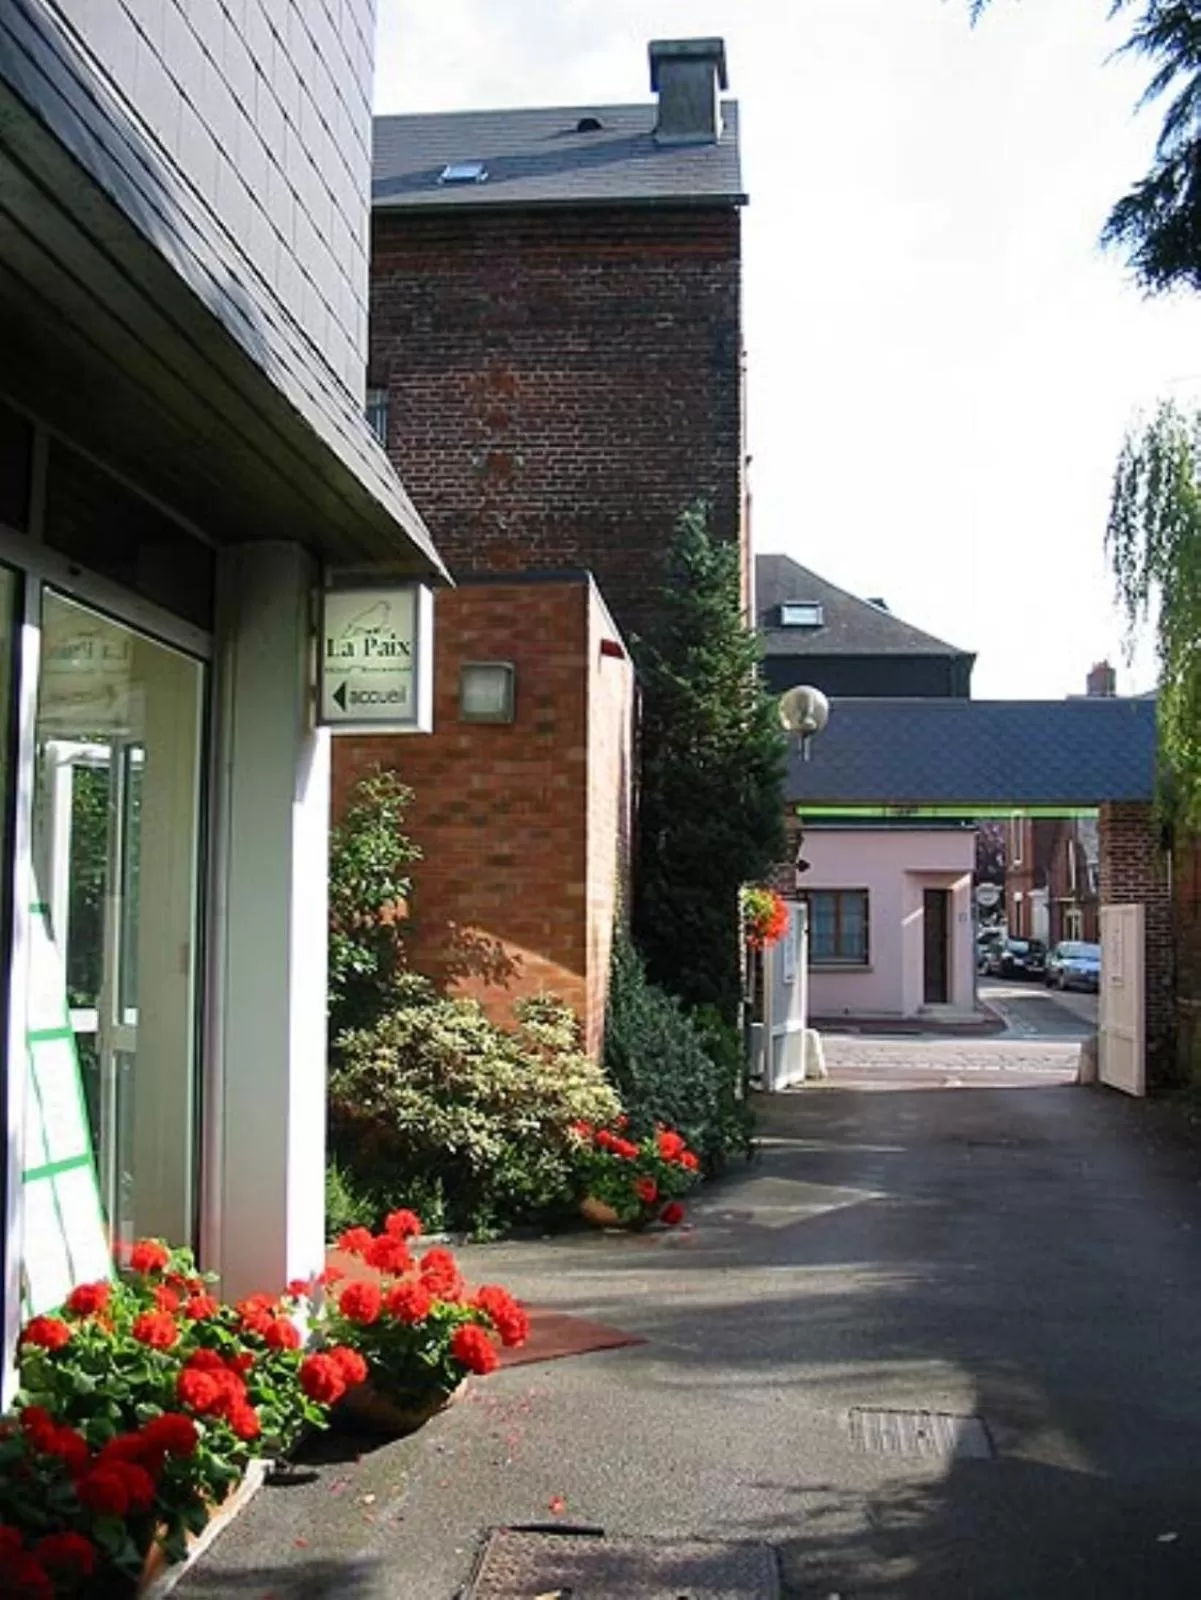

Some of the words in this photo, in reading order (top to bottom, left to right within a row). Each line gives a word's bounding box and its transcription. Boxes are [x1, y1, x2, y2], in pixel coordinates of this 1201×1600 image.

[327, 638, 354, 657] La
[364, 633, 410, 657] Paix
[349, 685, 406, 704] accueil
